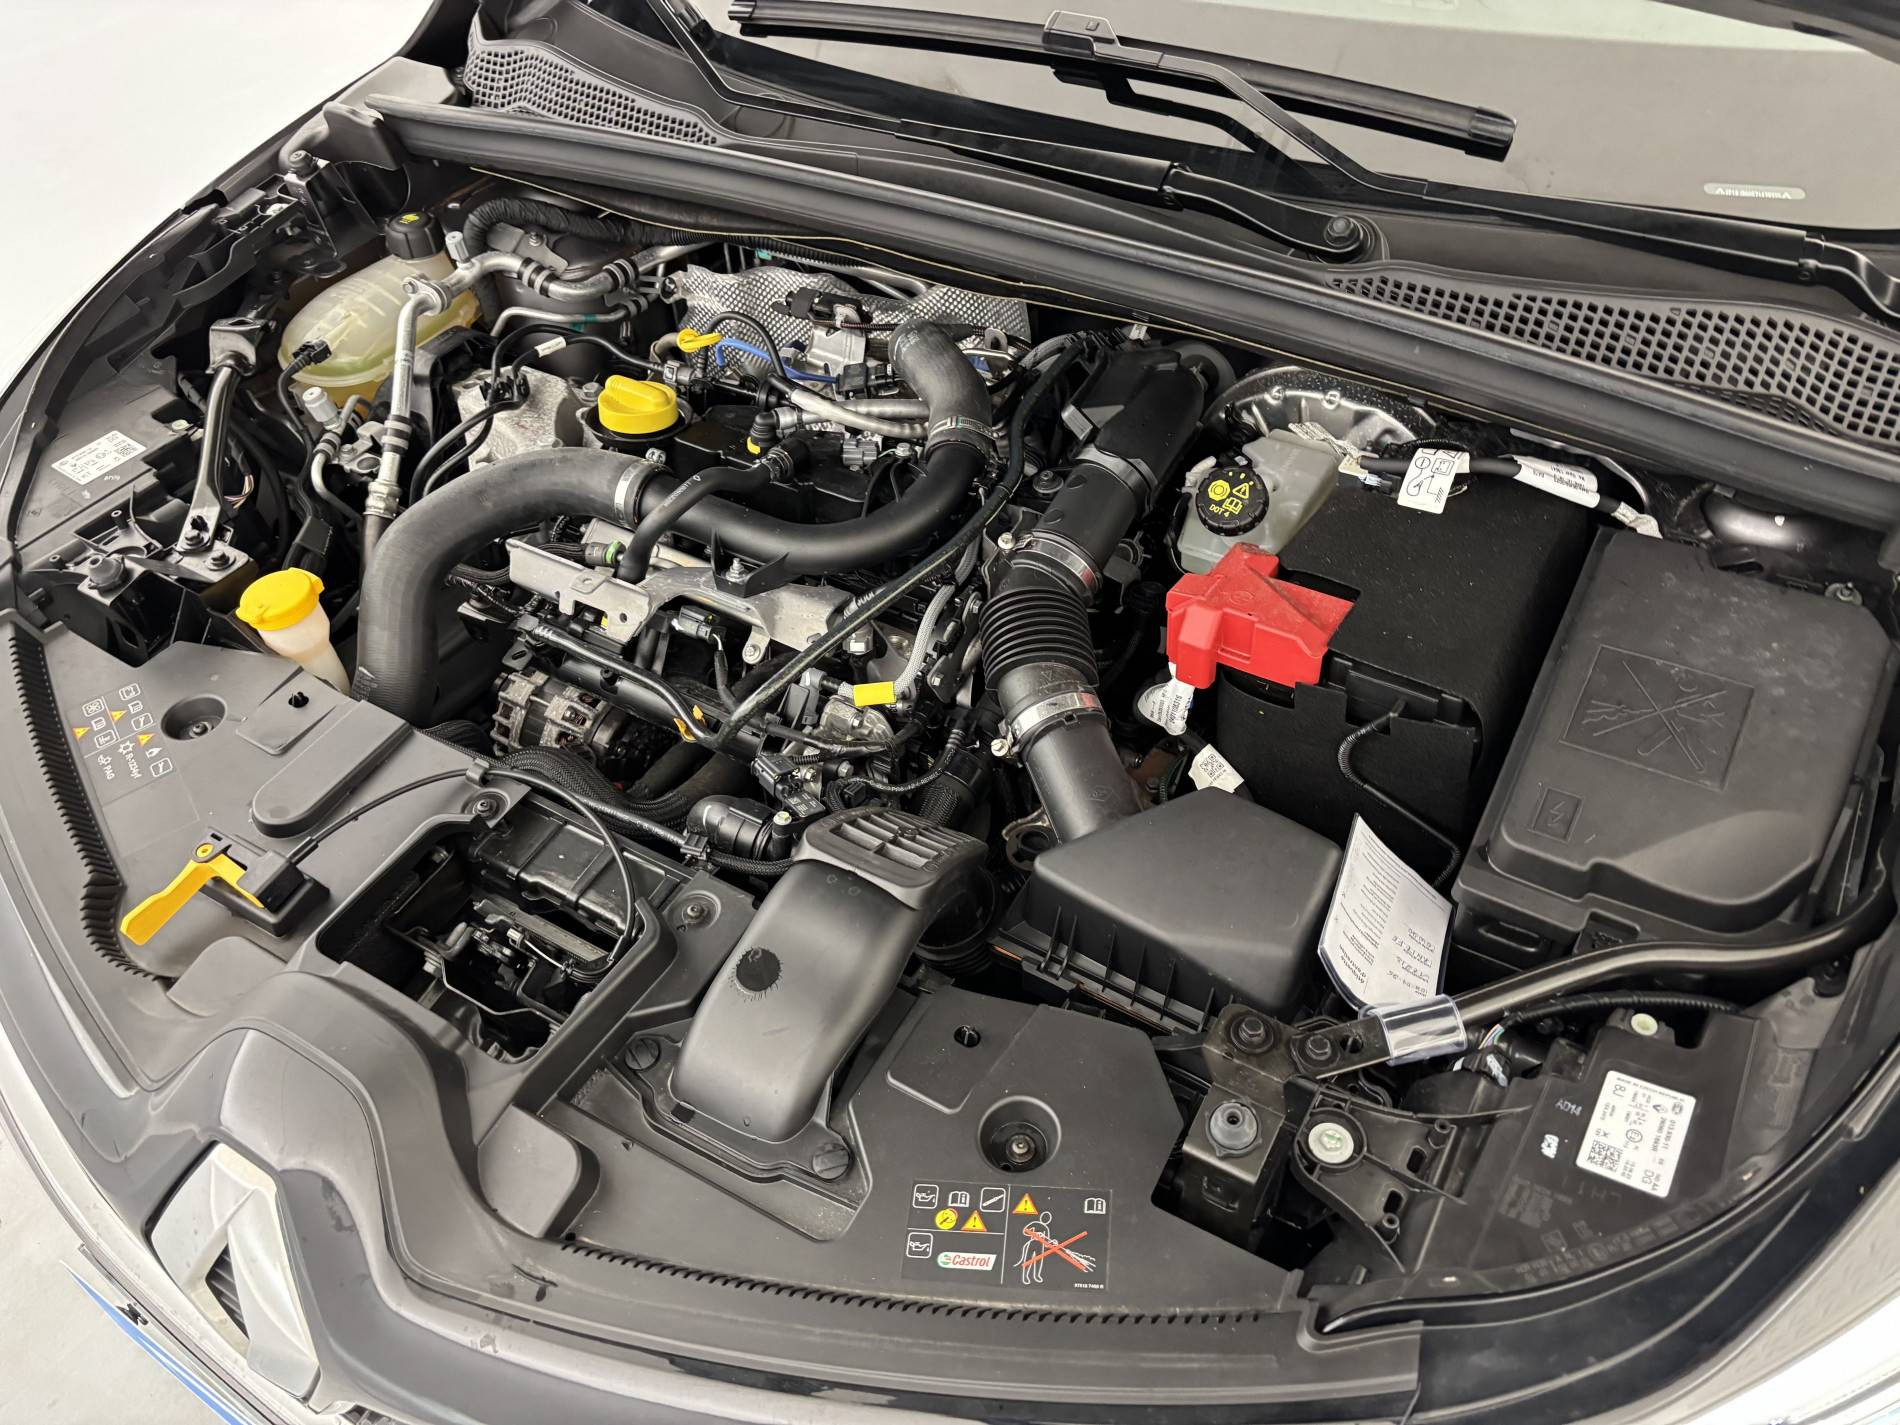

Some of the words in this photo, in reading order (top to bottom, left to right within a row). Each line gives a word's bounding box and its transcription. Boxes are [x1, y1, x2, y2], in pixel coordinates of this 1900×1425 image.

[1209, 504, 1225, 515] DOT
[103, 765, 116, 780] PAG
[951, 1254, 991, 1268] Castrol
